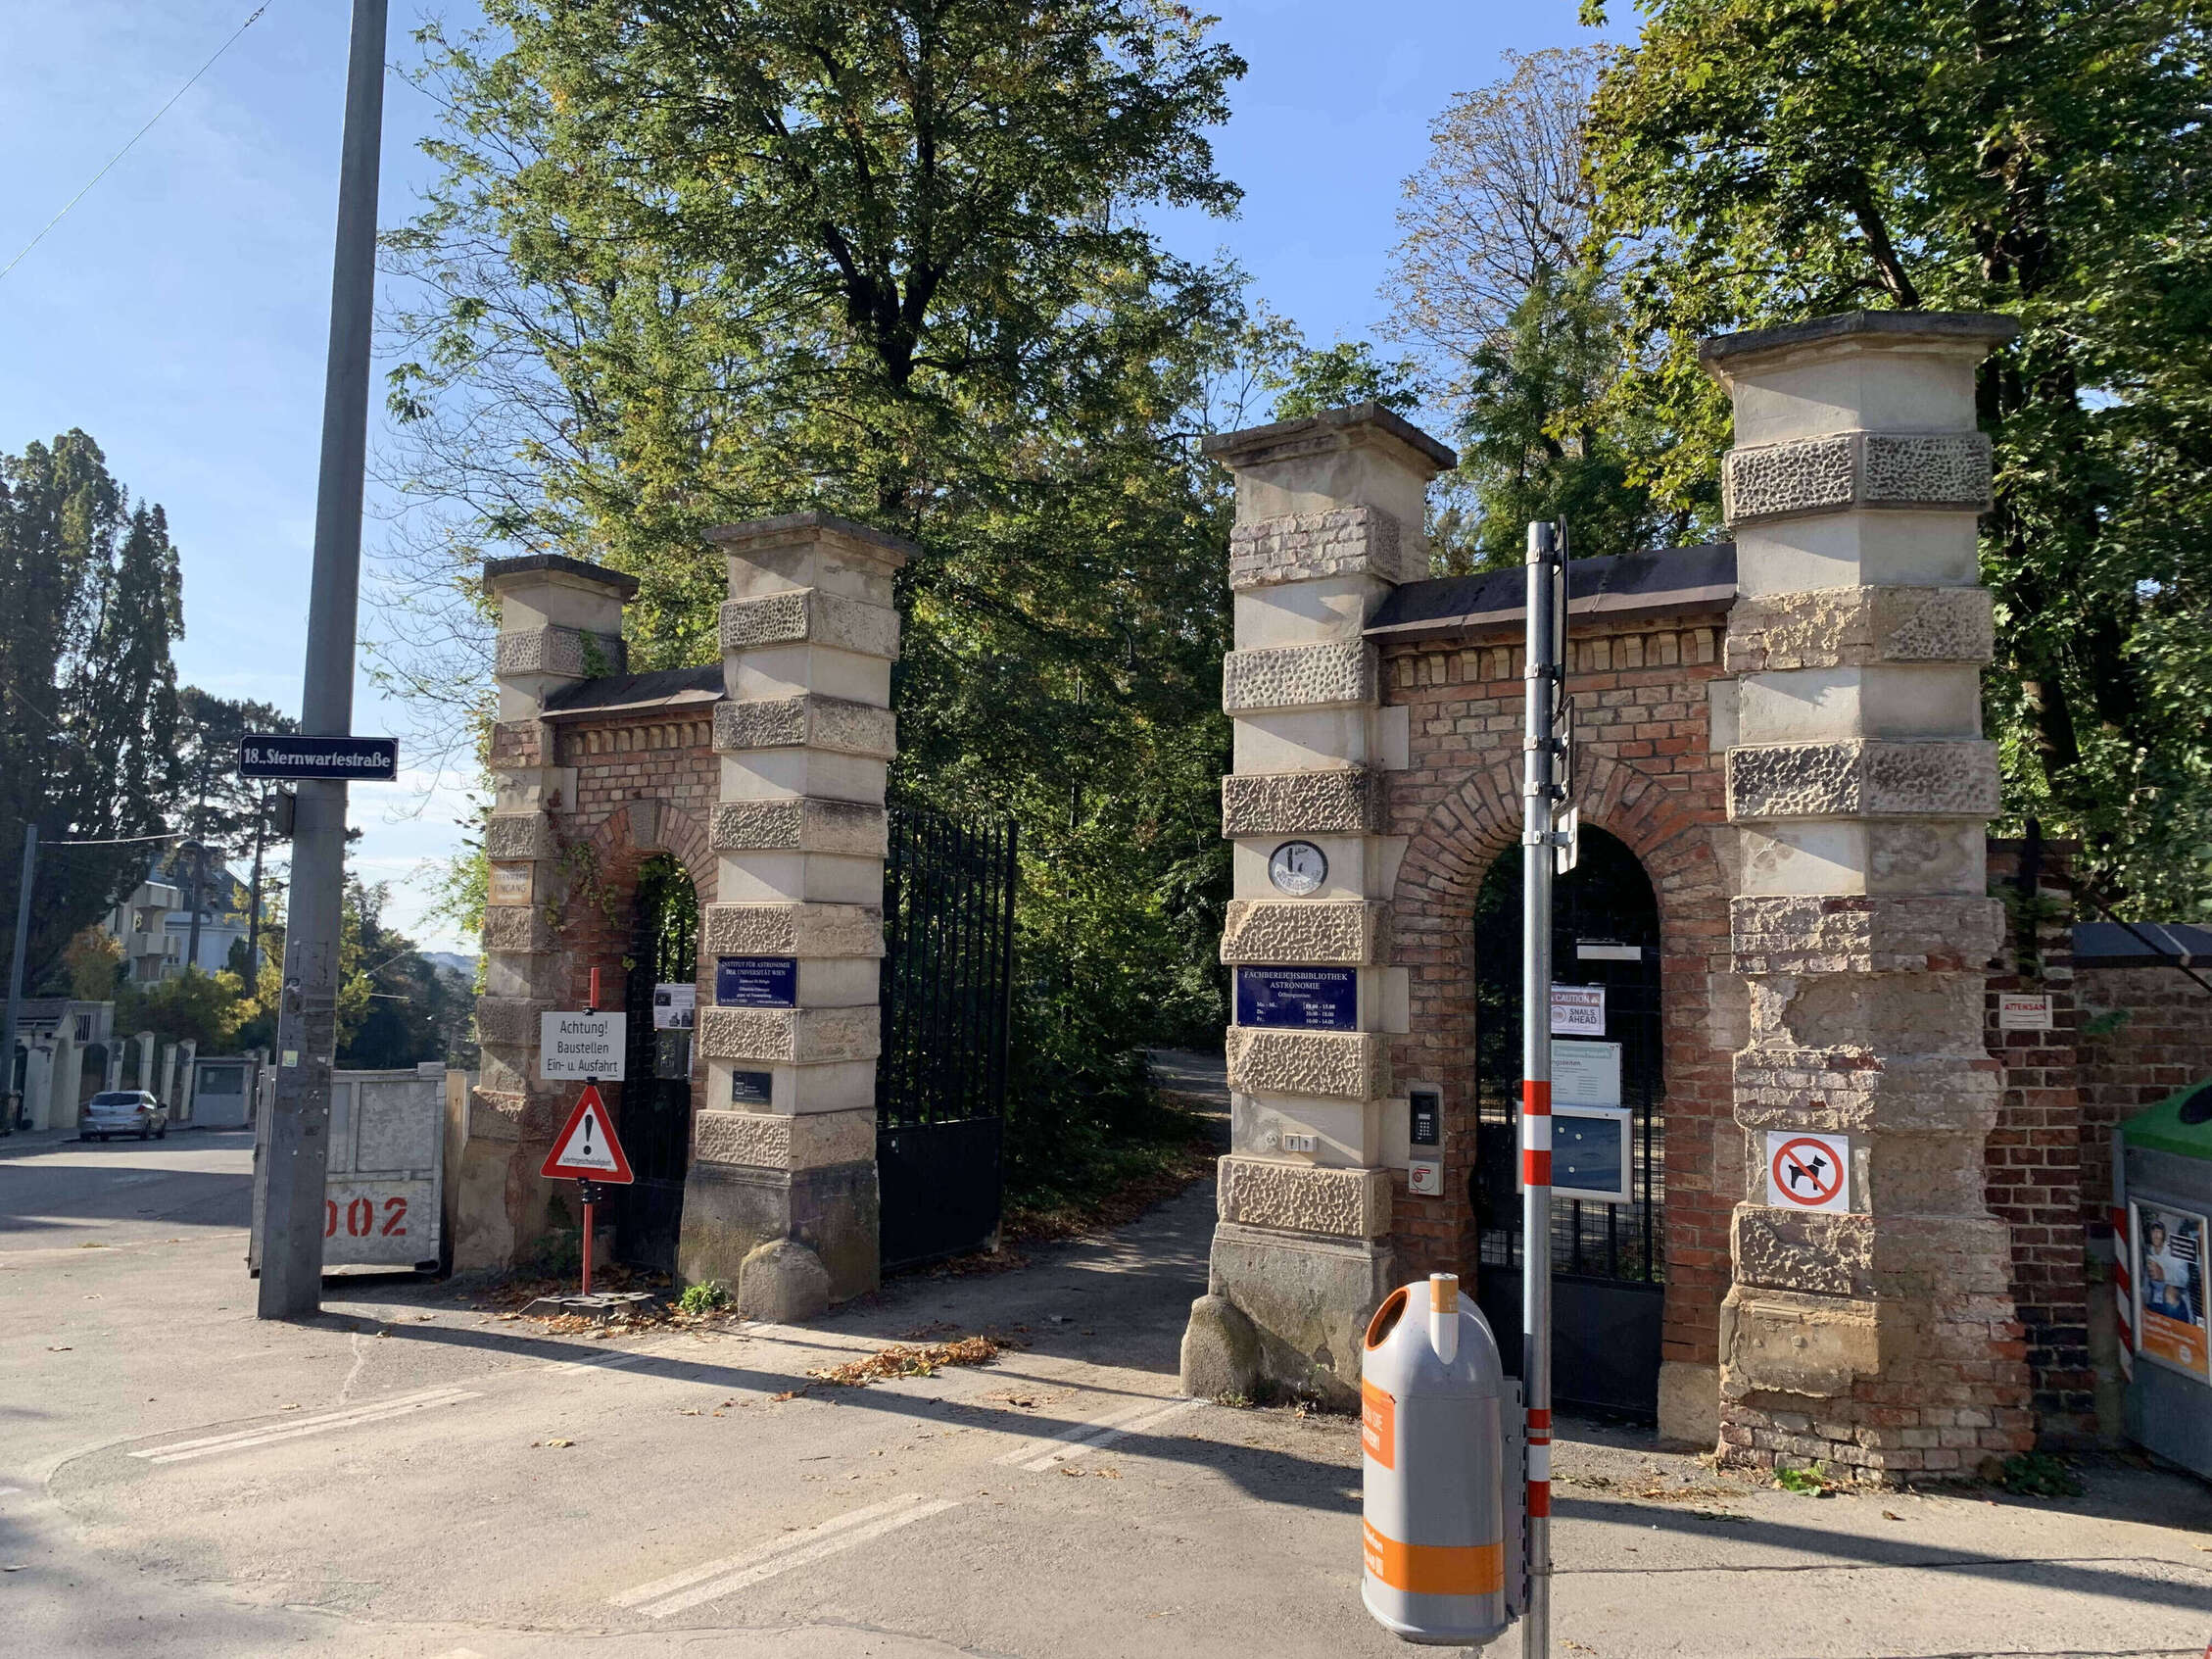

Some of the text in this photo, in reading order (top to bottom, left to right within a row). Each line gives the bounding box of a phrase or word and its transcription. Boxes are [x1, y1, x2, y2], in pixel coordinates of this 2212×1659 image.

[266, 749, 391, 767] Sternwartestraße
[1244, 971, 1348, 980] FACHBEREICHSBIBLIOTHEK
[1270, 981, 1321, 990] ASTRONOMIE
[1557, 994, 1590, 1003] CAUTION
[1569, 1007, 1595, 1016] SNAILS
[1568, 1015, 1597, 1024] AHEAD
[559, 1020, 608, 1037] Achtung!
[557, 1042, 609, 1054] Baustellen
[547, 1059, 564, 1071] Ein-
[579, 1059, 618, 1072] Ausfahrt
